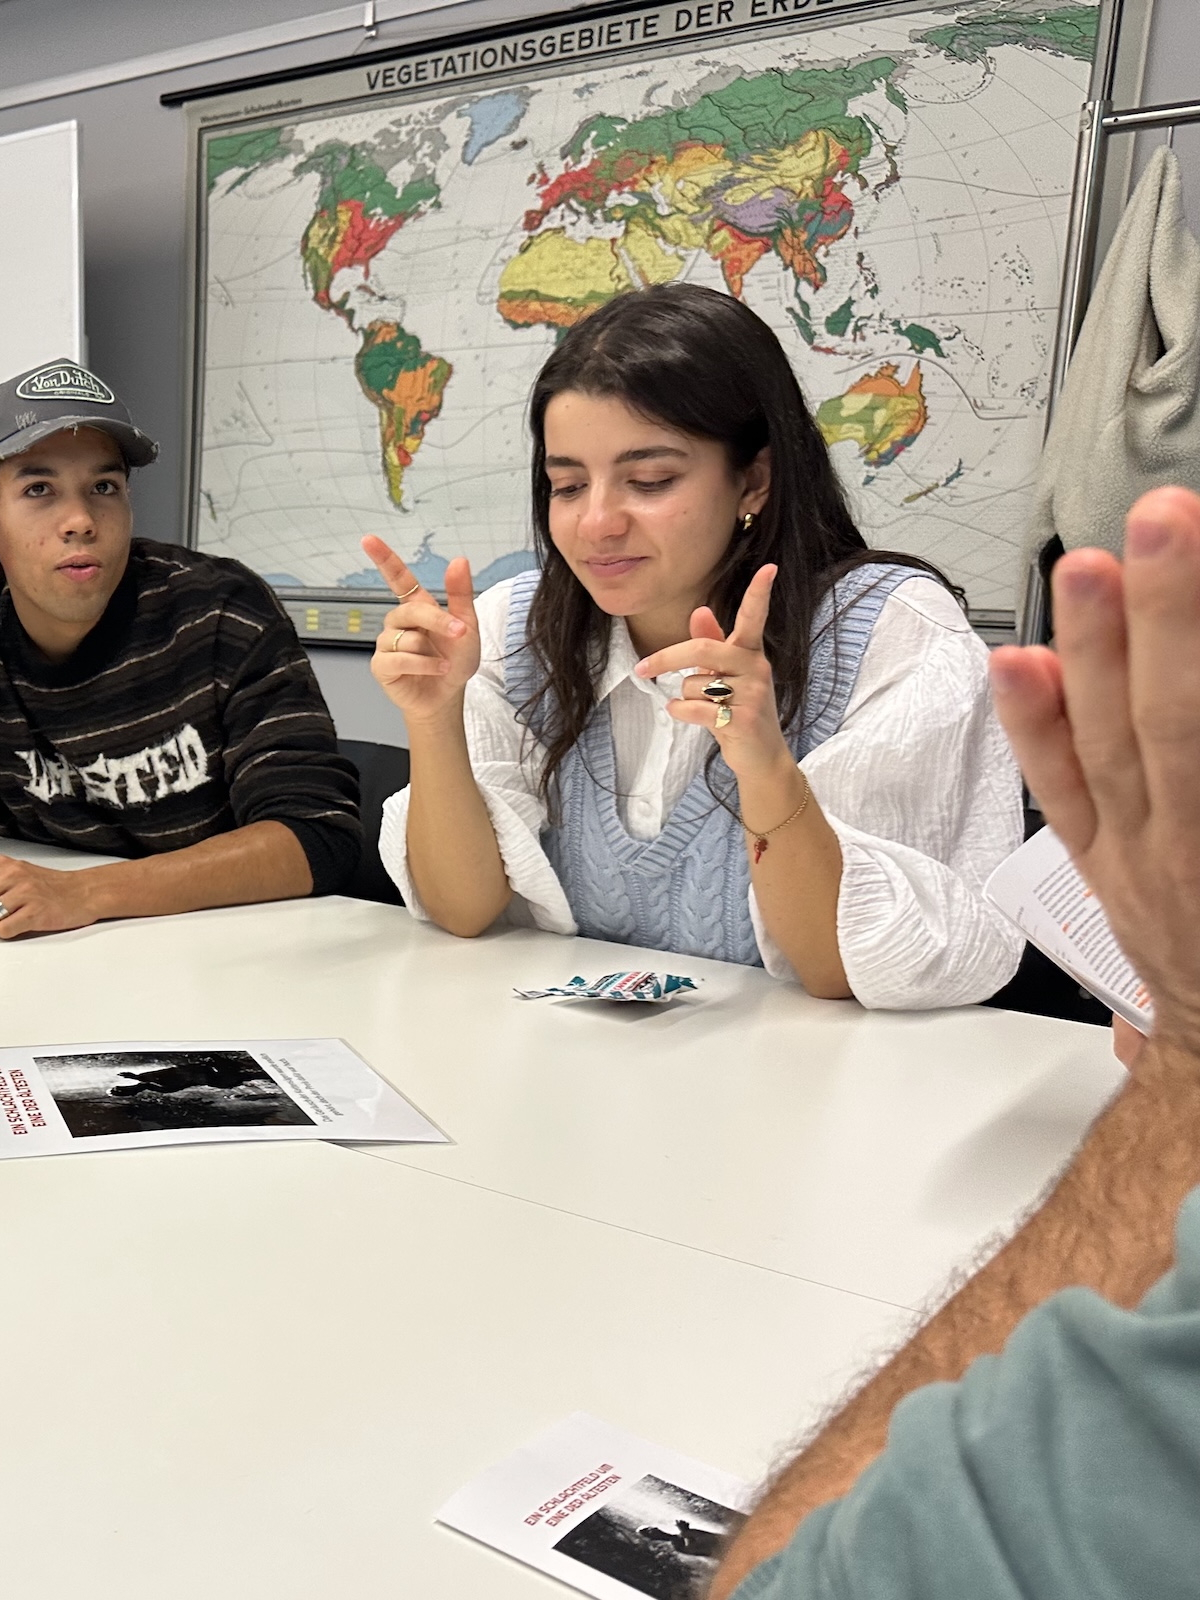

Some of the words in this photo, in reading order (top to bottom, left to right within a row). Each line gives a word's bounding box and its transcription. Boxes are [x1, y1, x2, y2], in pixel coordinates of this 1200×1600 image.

[367, 14, 660, 91] VEGETATIONSGEBIETE
[675, 1, 735, 32] DER
[31, 375, 60, 390] Von
[60, 370, 100, 393] Dutch
[8, 1069, 34, 1097] ÄLTESTEN
[21, 1099, 40, 1111] DER
[10, 1123, 29, 1135] EIN
[27, 1112, 47, 1127] EINE
[524, 1511, 544, 1526] EIN
[538, 1472, 600, 1514] SCHLACHTFELD
[545, 1510, 570, 1527] EINE
[564, 1498, 586, 1512] DER
[578, 1474, 622, 1501] ÄLTESTEN
